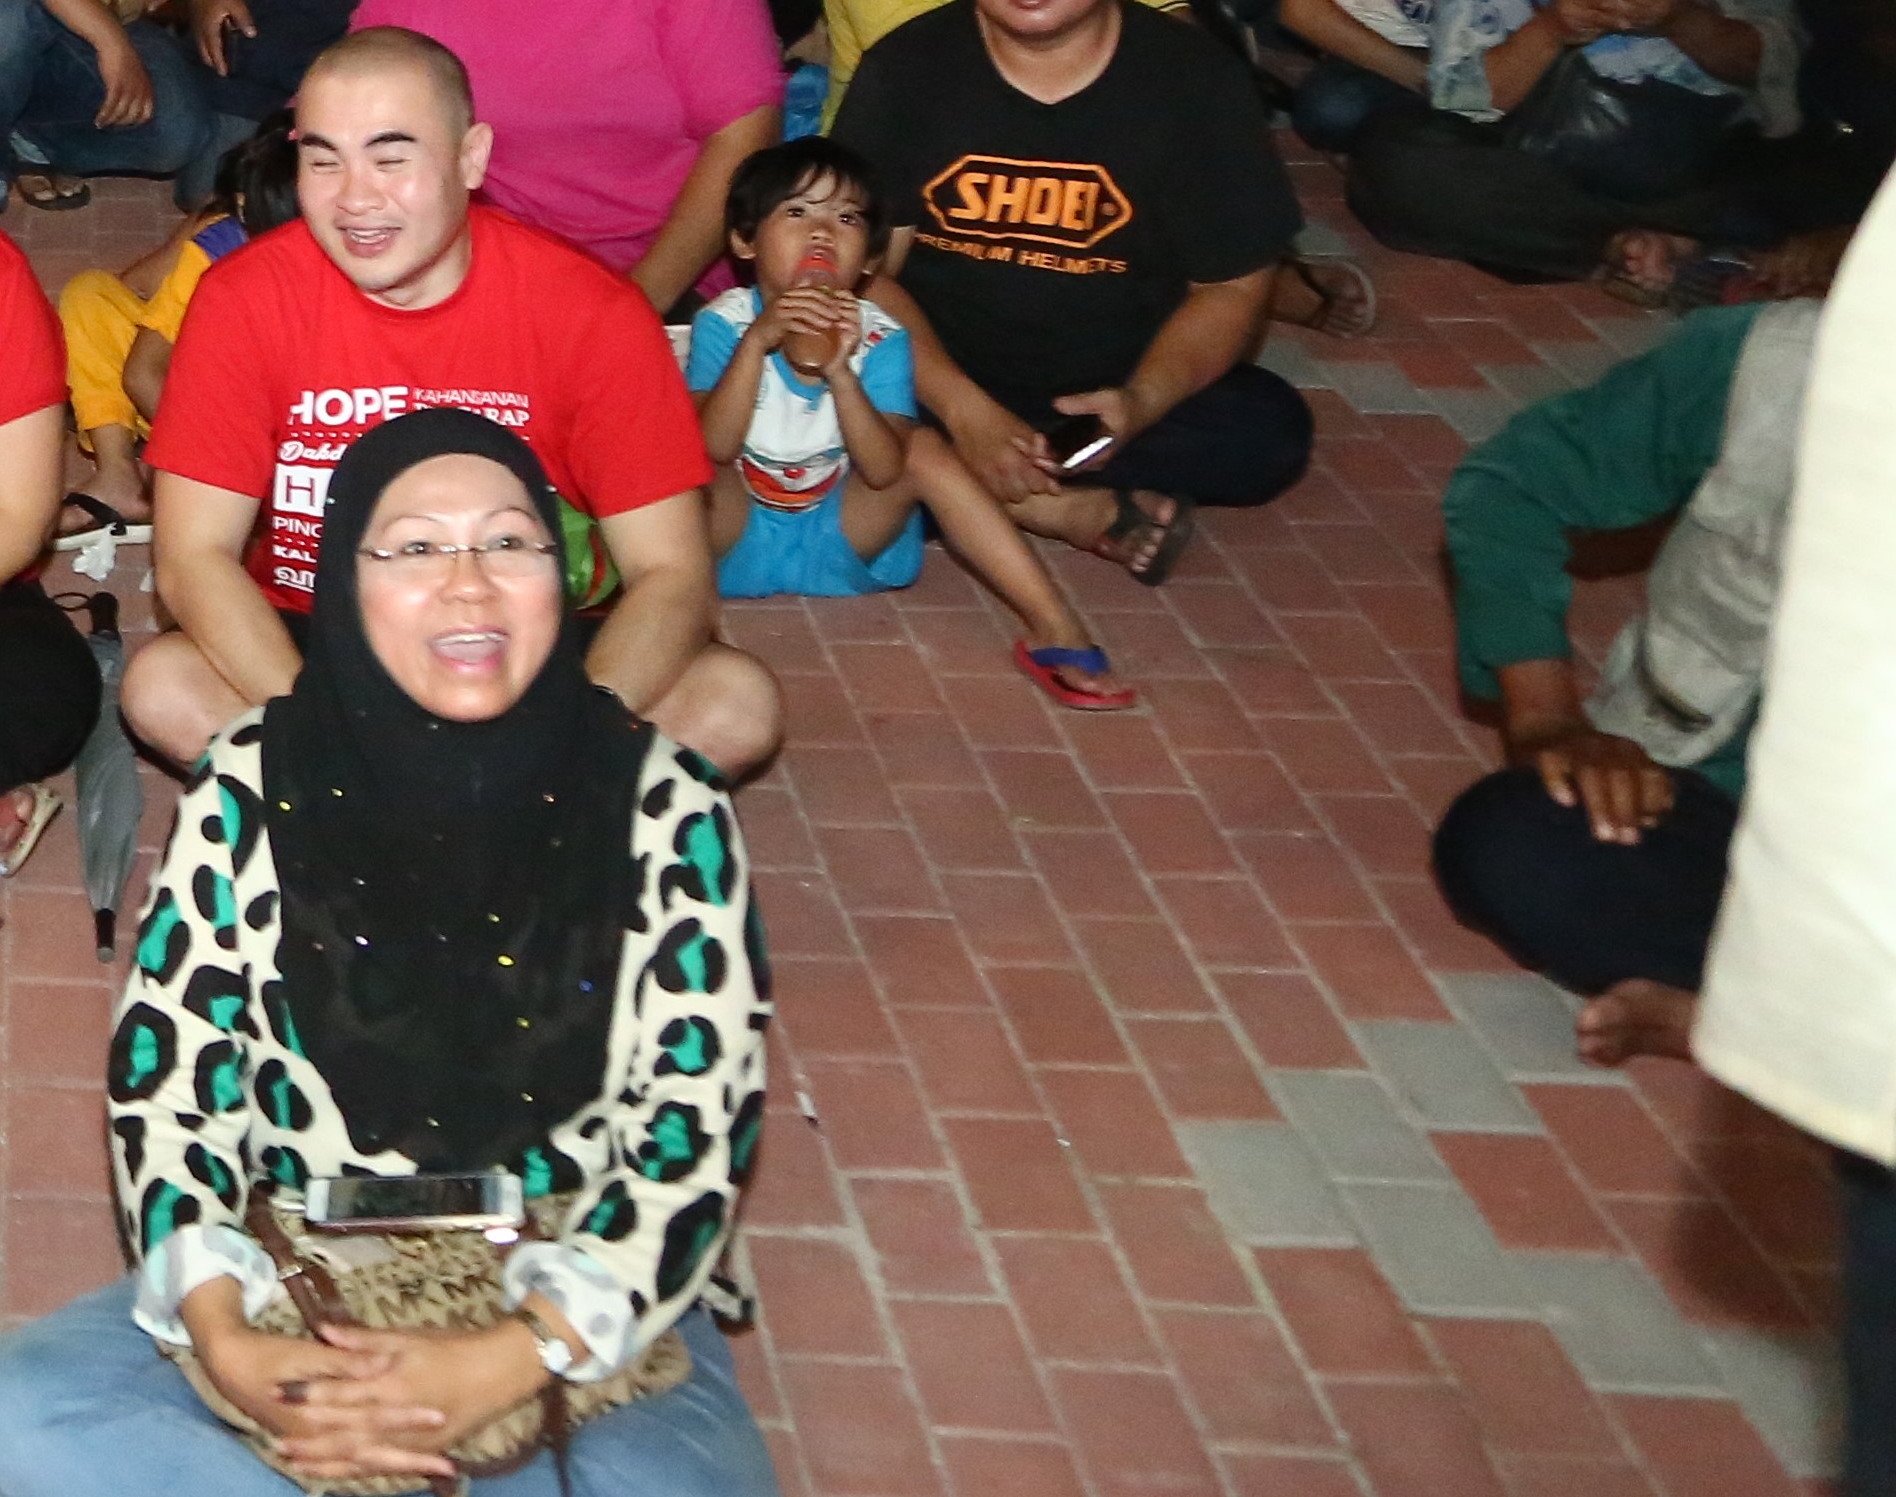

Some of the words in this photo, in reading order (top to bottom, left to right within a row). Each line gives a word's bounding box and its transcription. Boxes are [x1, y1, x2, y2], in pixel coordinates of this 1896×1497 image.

[948, 172, 1100, 231] SHOEI
[287, 386, 408, 425] HOPE
[413, 387, 530, 408] KAHANSANAN
[280, 440, 349, 462] Dakd
